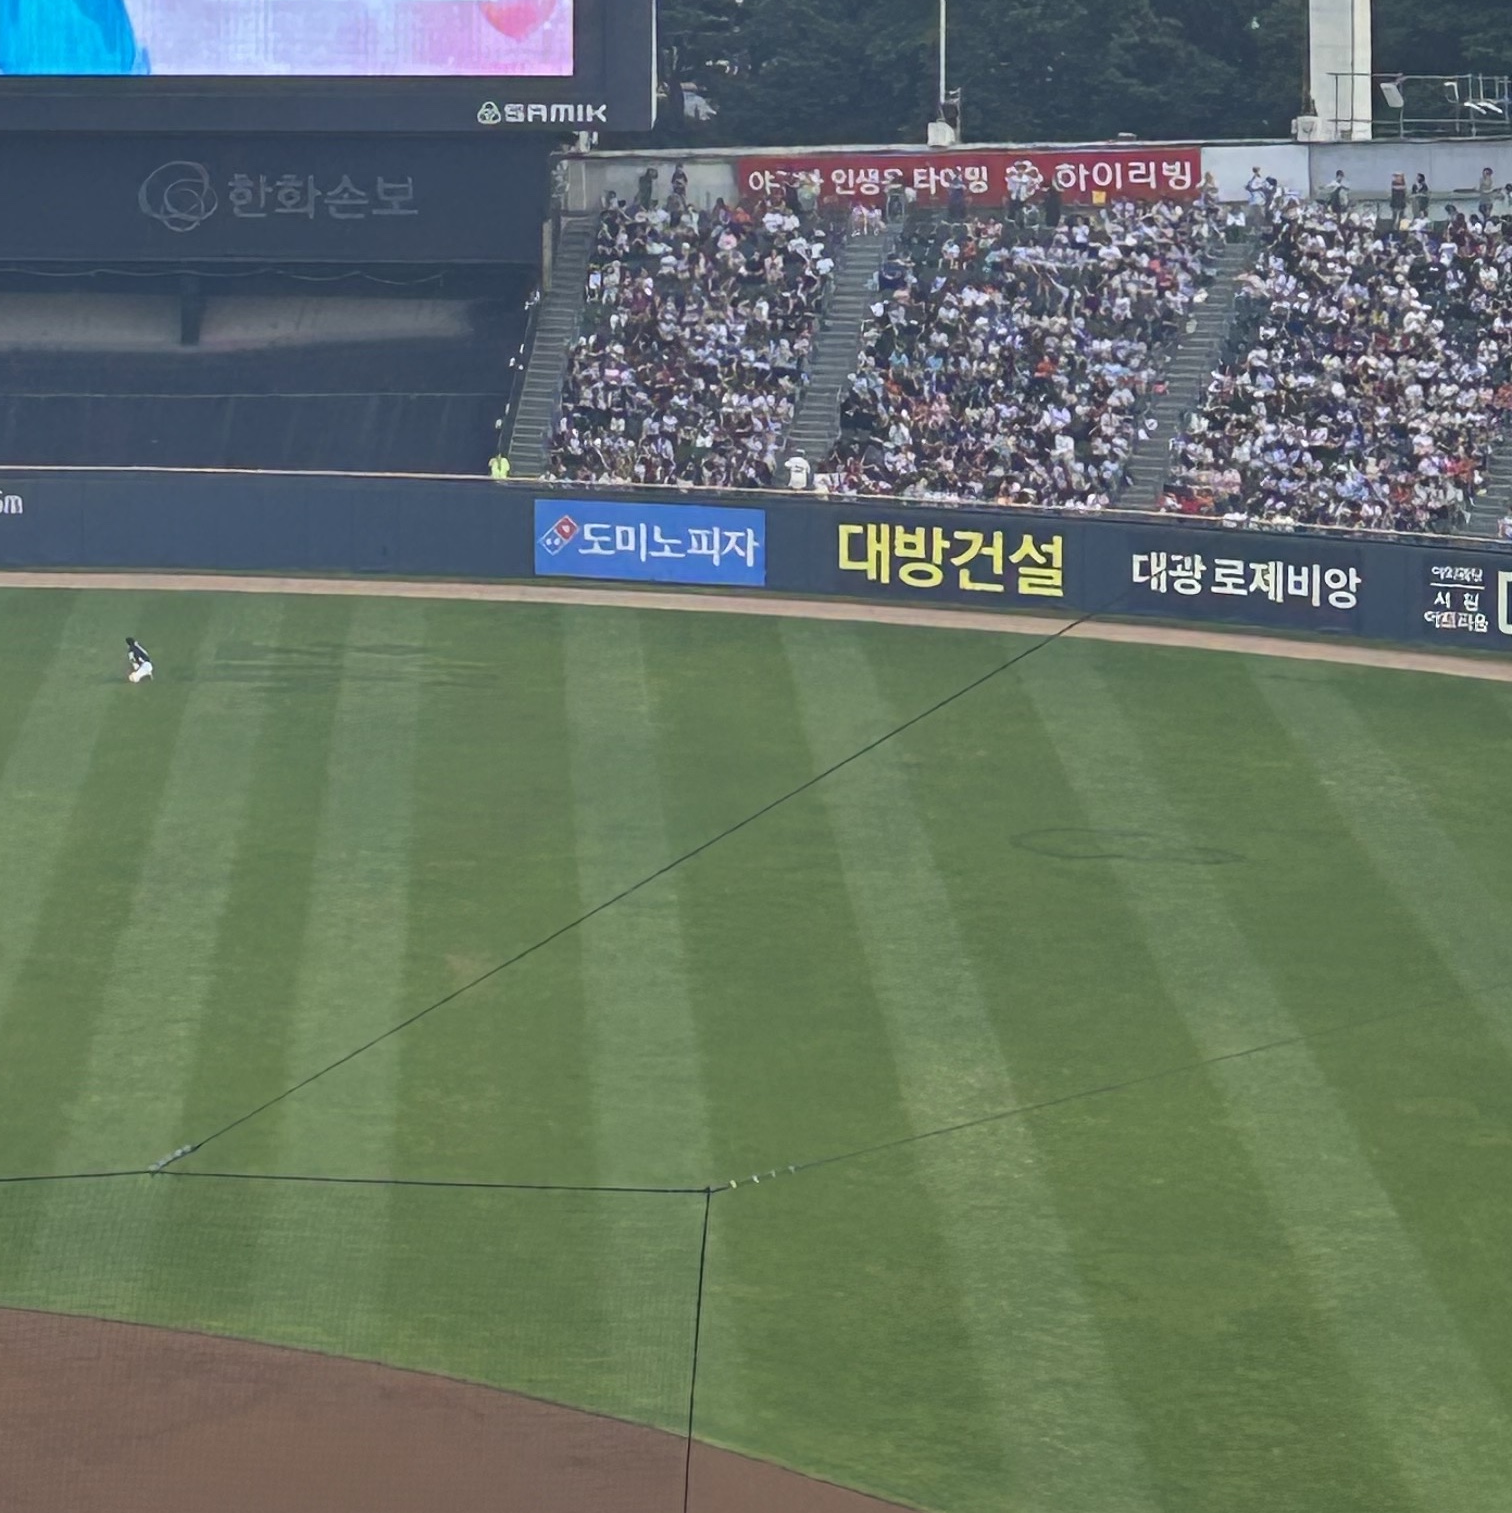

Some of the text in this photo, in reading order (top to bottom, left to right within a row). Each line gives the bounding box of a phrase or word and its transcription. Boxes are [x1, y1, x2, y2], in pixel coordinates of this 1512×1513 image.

[504, 103, 607, 123] SAMIK
[228, 172, 419, 220] 한화손보
[1054, 161, 1192, 192] 하이리빙
[578, 522, 760, 568] 도미노피자
[838, 523, 1064, 597] 대방건설
[1132, 551, 1362, 609] 대광 로제비앙
